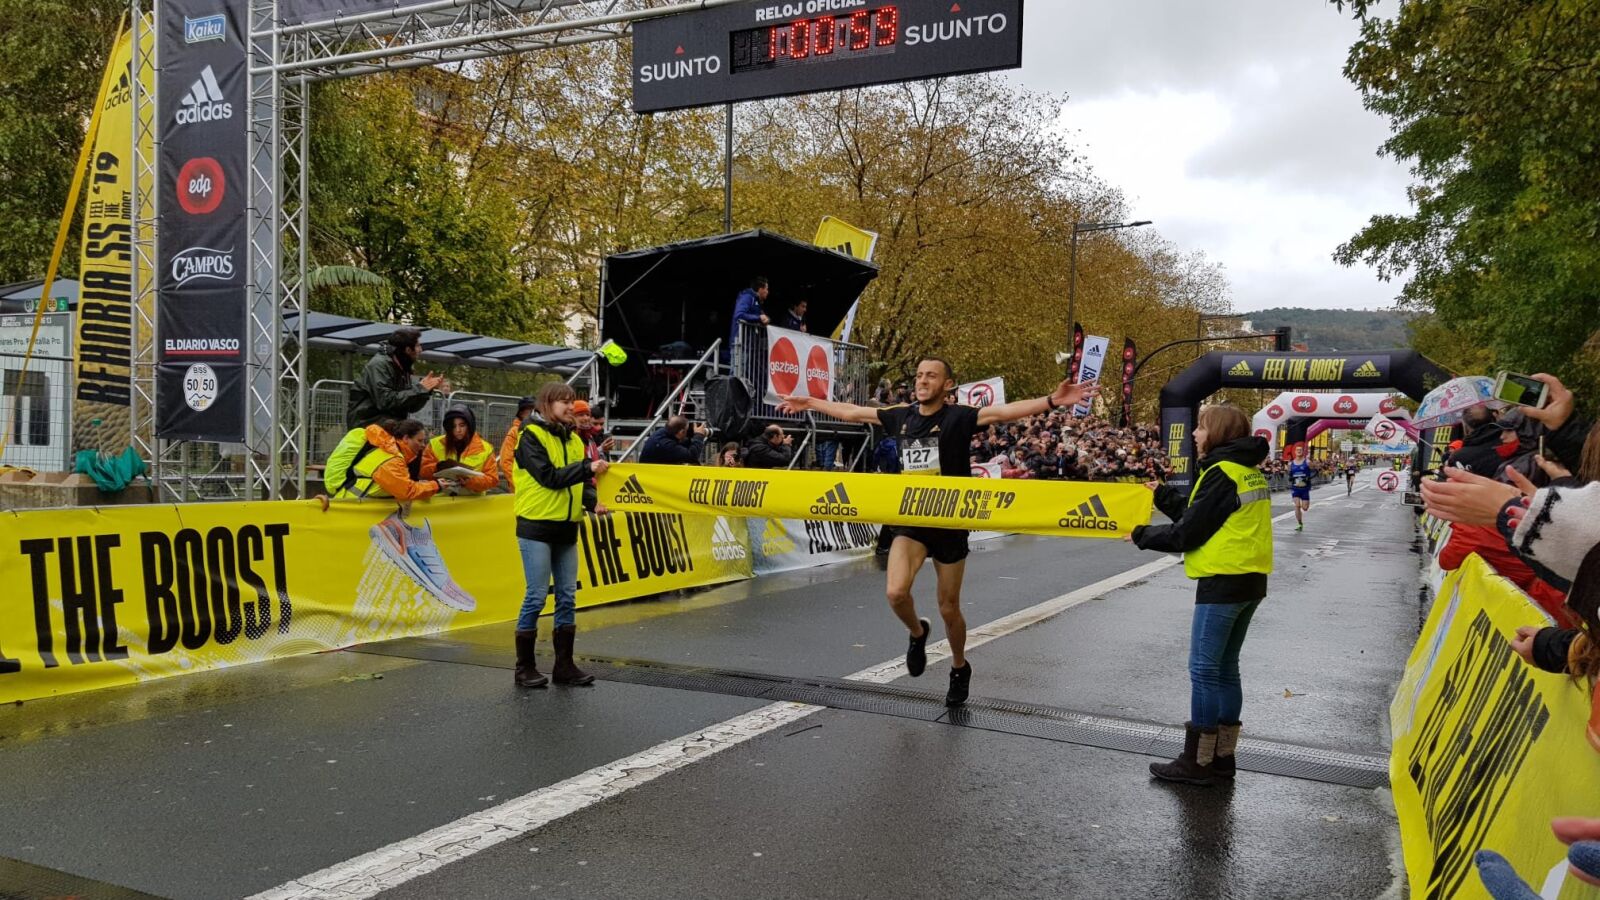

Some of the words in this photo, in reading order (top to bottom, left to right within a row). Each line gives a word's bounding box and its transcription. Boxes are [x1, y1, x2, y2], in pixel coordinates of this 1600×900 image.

[755, 4, 802, 21] RELOJ
[806, 0, 866, 13] OFICIAL
[188, 21, 221, 41] Kaiku
[904, 13, 1008, 46] SUUNTO
[639, 55, 721, 83] SUUNTO
[175, 101, 233, 125] adidas
[188, 173, 212, 198] edp
[103, 202, 120, 219] THE
[172, 255, 233, 281] CAMPOS
[59, 299, 65, 311] 5
[165, 339, 177, 350] EL
[177, 339, 208, 350] DIARIO
[208, 339, 240, 350] VASCO
[1261, 358, 1287, 381] FEEL
[1287, 358, 1310, 381] THE
[1308, 358, 1347, 381] BOOST
[1169, 423, 1185, 440] FEEL
[905, 449, 931, 463] 127
[1168, 440, 1181, 456] THE
[614, 490, 654, 505] adidas
[688, 478, 709, 504] FEEL
[710, 479, 730, 507] THE
[730, 480, 769, 508] BOOST
[898, 486, 961, 518] BEHOBIA
[809, 502, 858, 517] adidas
[1058, 513, 1118, 532] adidas
[579, 511, 631, 588] THE
[711, 540, 746, 562] adidas
[20, 533, 129, 668] THE
[139, 523, 292, 655] BOOST
